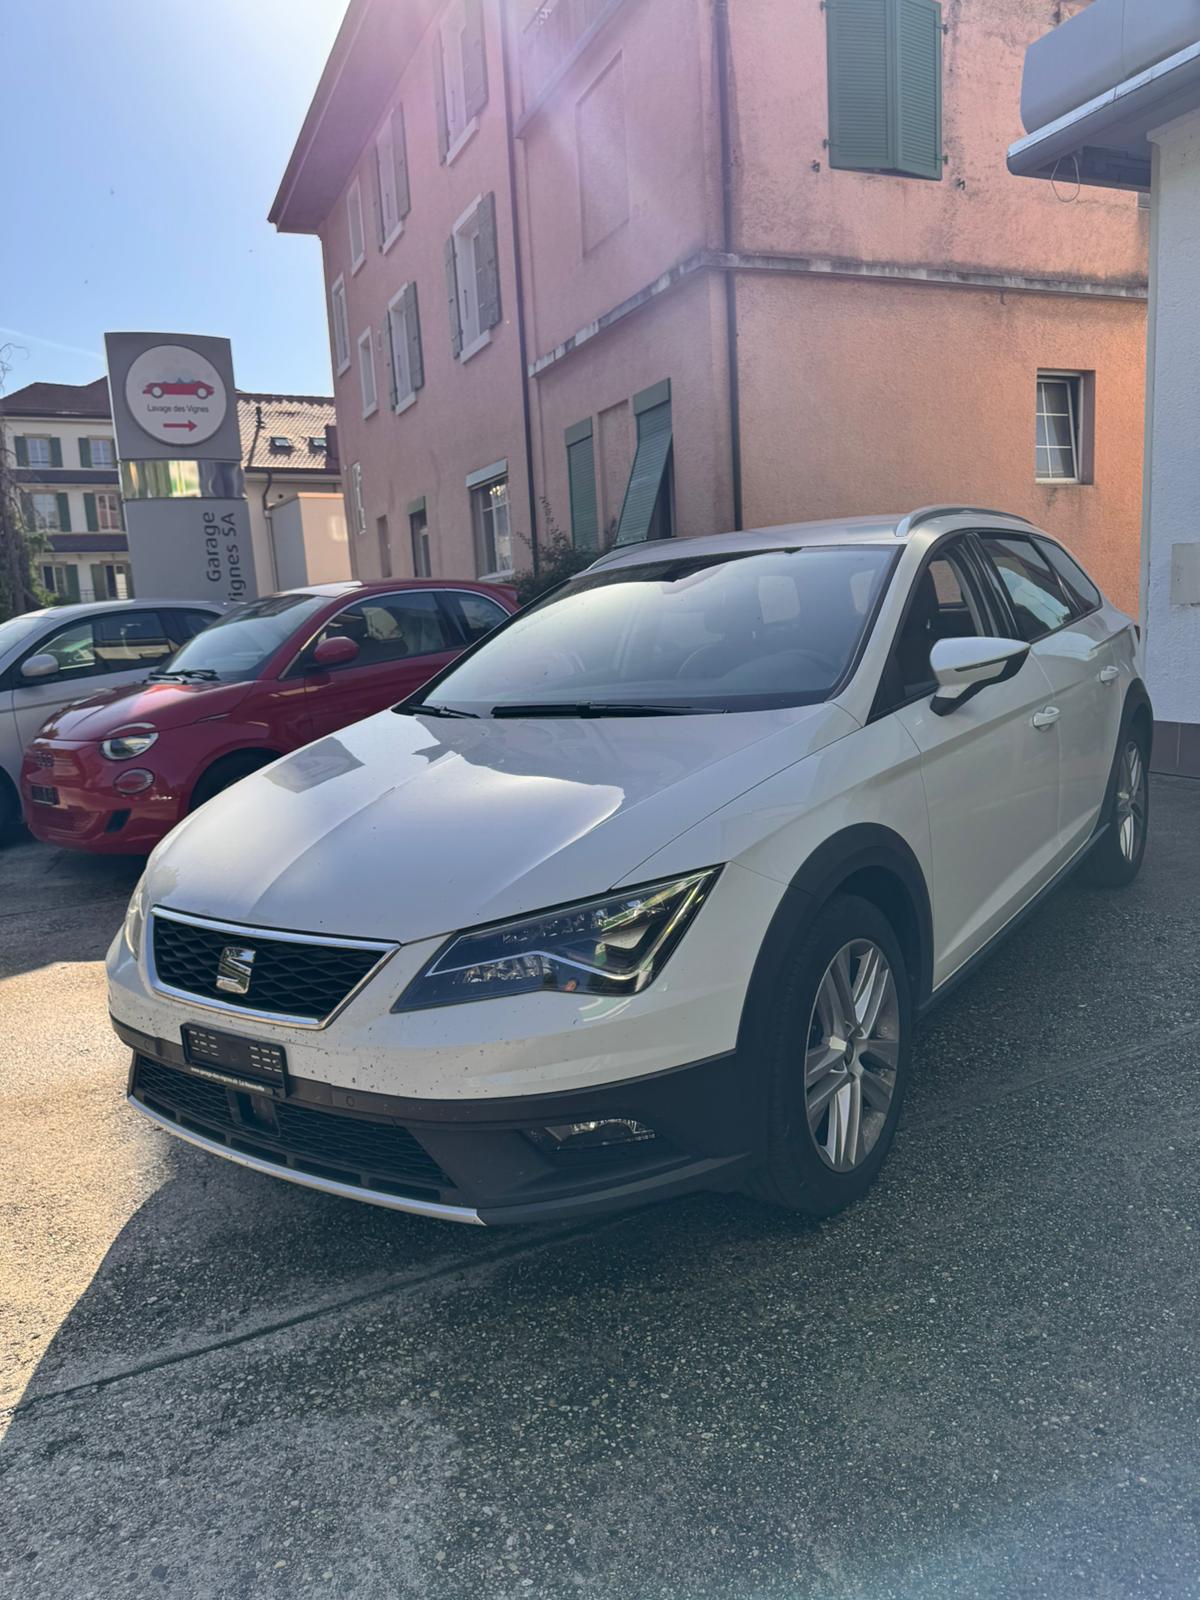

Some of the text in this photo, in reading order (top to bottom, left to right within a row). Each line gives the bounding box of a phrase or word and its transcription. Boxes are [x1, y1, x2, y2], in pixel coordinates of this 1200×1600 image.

[147, 404, 209, 414] Lavage des Vignes
[221, 512, 237, 536] SA
[203, 512, 221, 582] Garage
